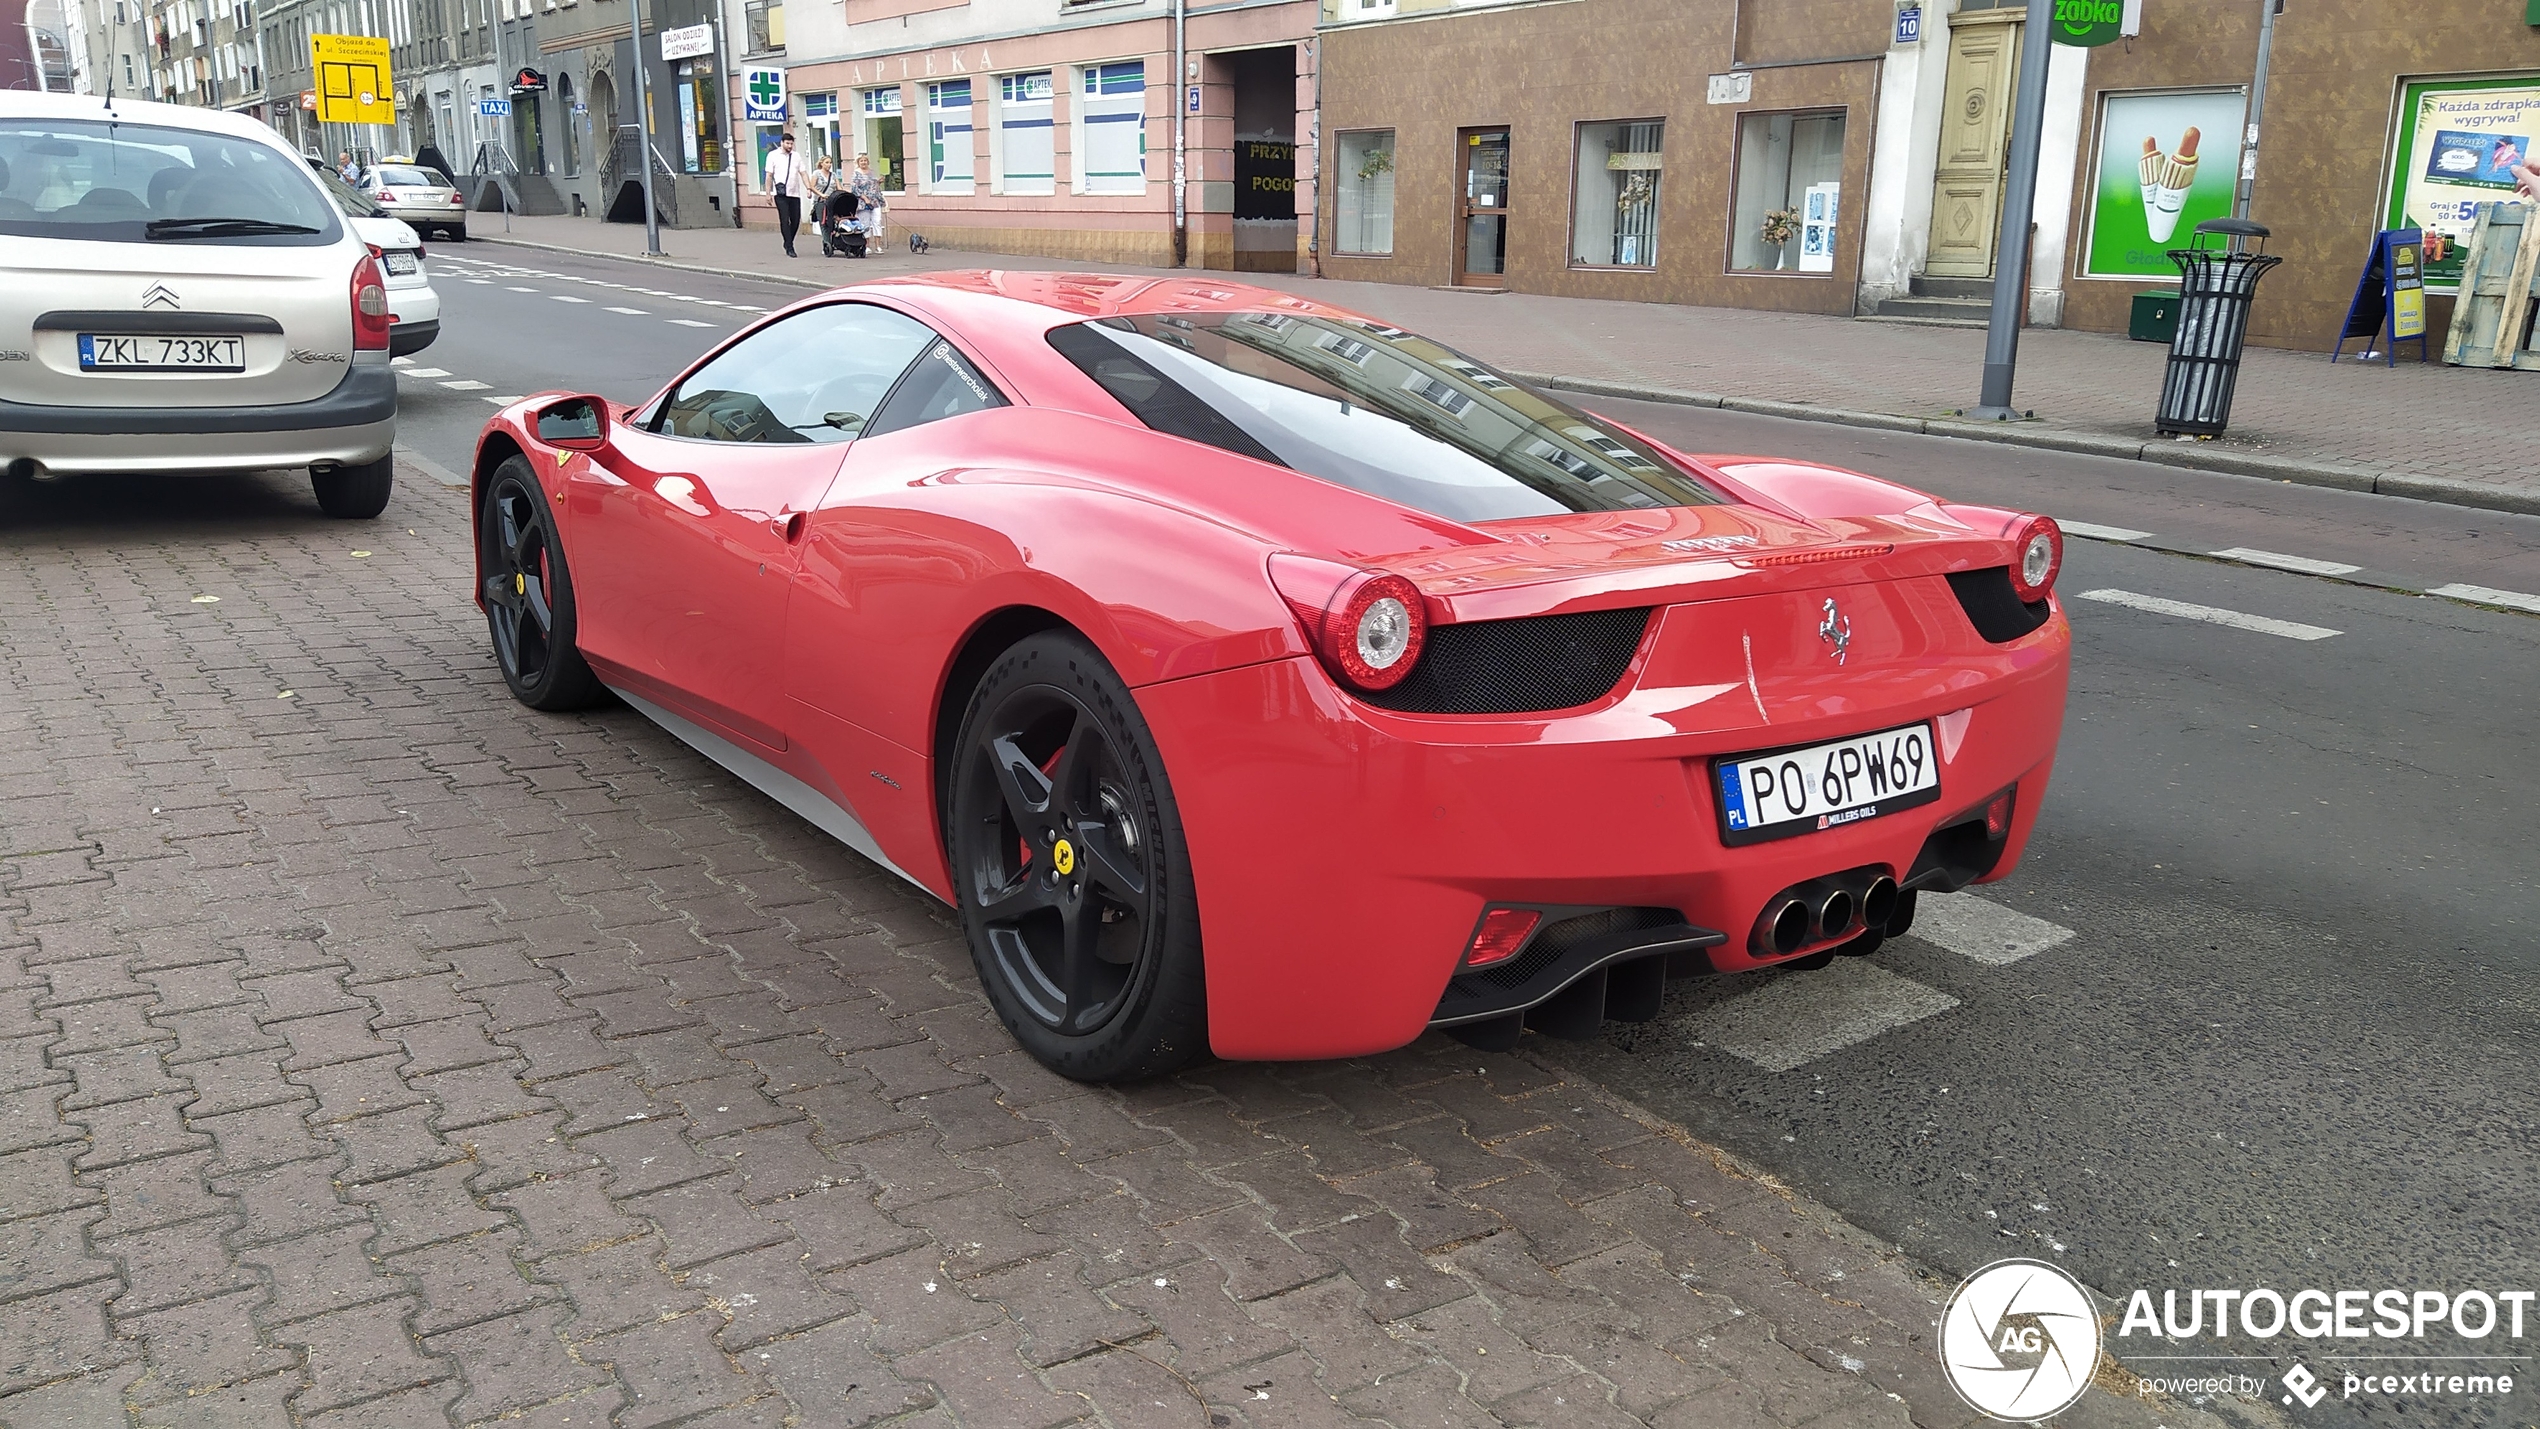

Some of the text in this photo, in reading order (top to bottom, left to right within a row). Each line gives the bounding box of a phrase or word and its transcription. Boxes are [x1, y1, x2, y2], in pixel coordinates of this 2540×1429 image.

[1900, 20, 1916, 35] 10
[851, 48, 993, 84] APTEKA
[482, 102, 509, 115] TAXI
[2439, 98, 2540, 112] Każda zdrapka
[750, 110, 785, 120] APTEKA
[2454, 112, 2521, 128] wygrywa!
[2430, 202, 2450, 211] Graj
[2437, 212, 2450, 220] 50
[82, 353, 94, 362] PL
[96, 338, 239, 364] ZKL 733KT
[288, 348, 346, 364] Xsara
[1749, 734, 1924, 824] PO 6PW69
[1728, 808, 1746, 826] PL
[1828, 805, 1877, 826] MILLERS OILS
